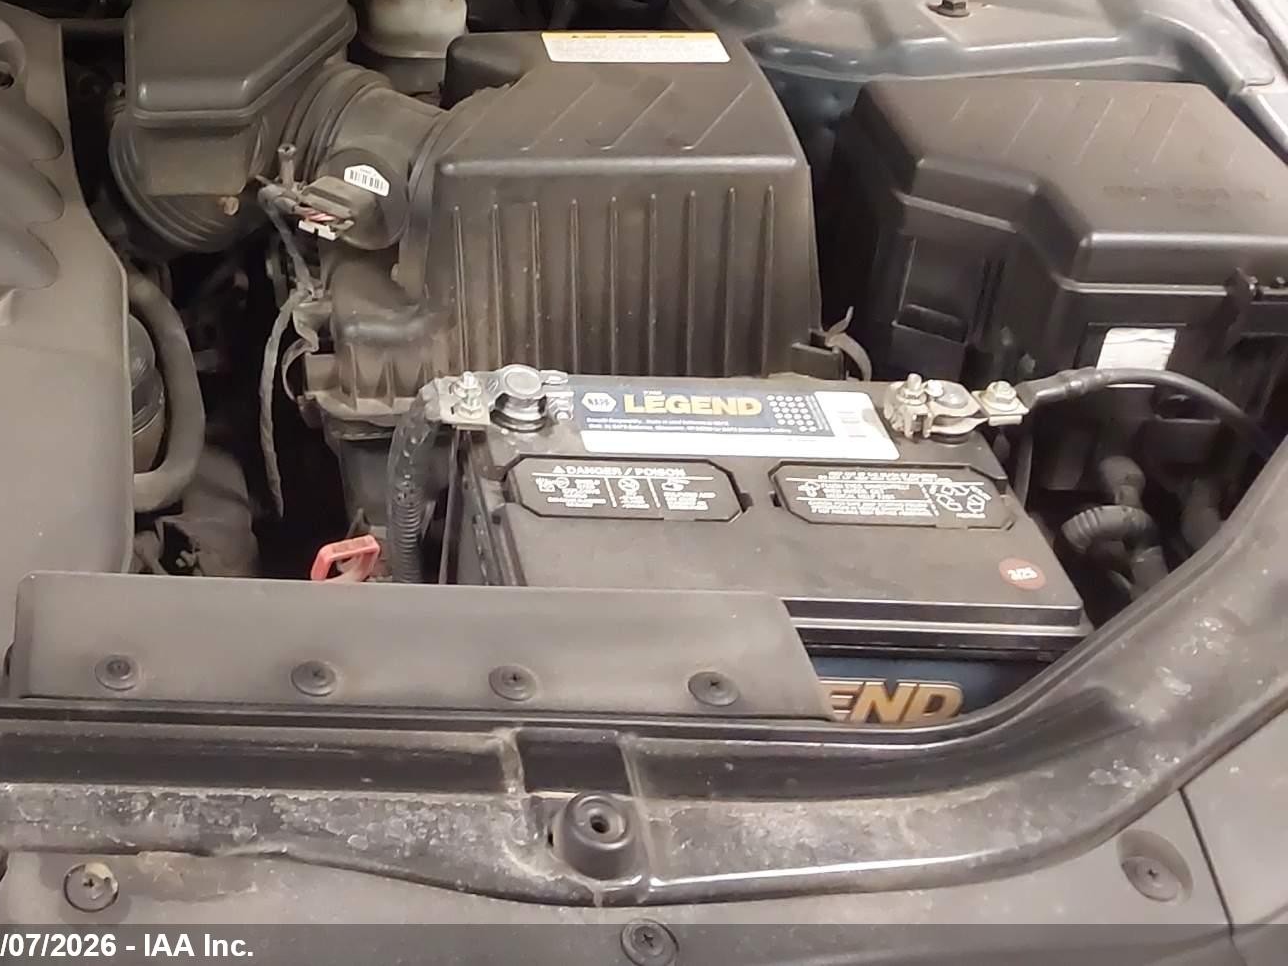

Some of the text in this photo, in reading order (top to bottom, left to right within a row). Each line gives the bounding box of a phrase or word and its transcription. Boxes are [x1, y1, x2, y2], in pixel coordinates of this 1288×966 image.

[623, 393, 763, 417] LEGEND
[565, 465, 622, 476] DANGER
[634, 467, 687, 478] POISON
